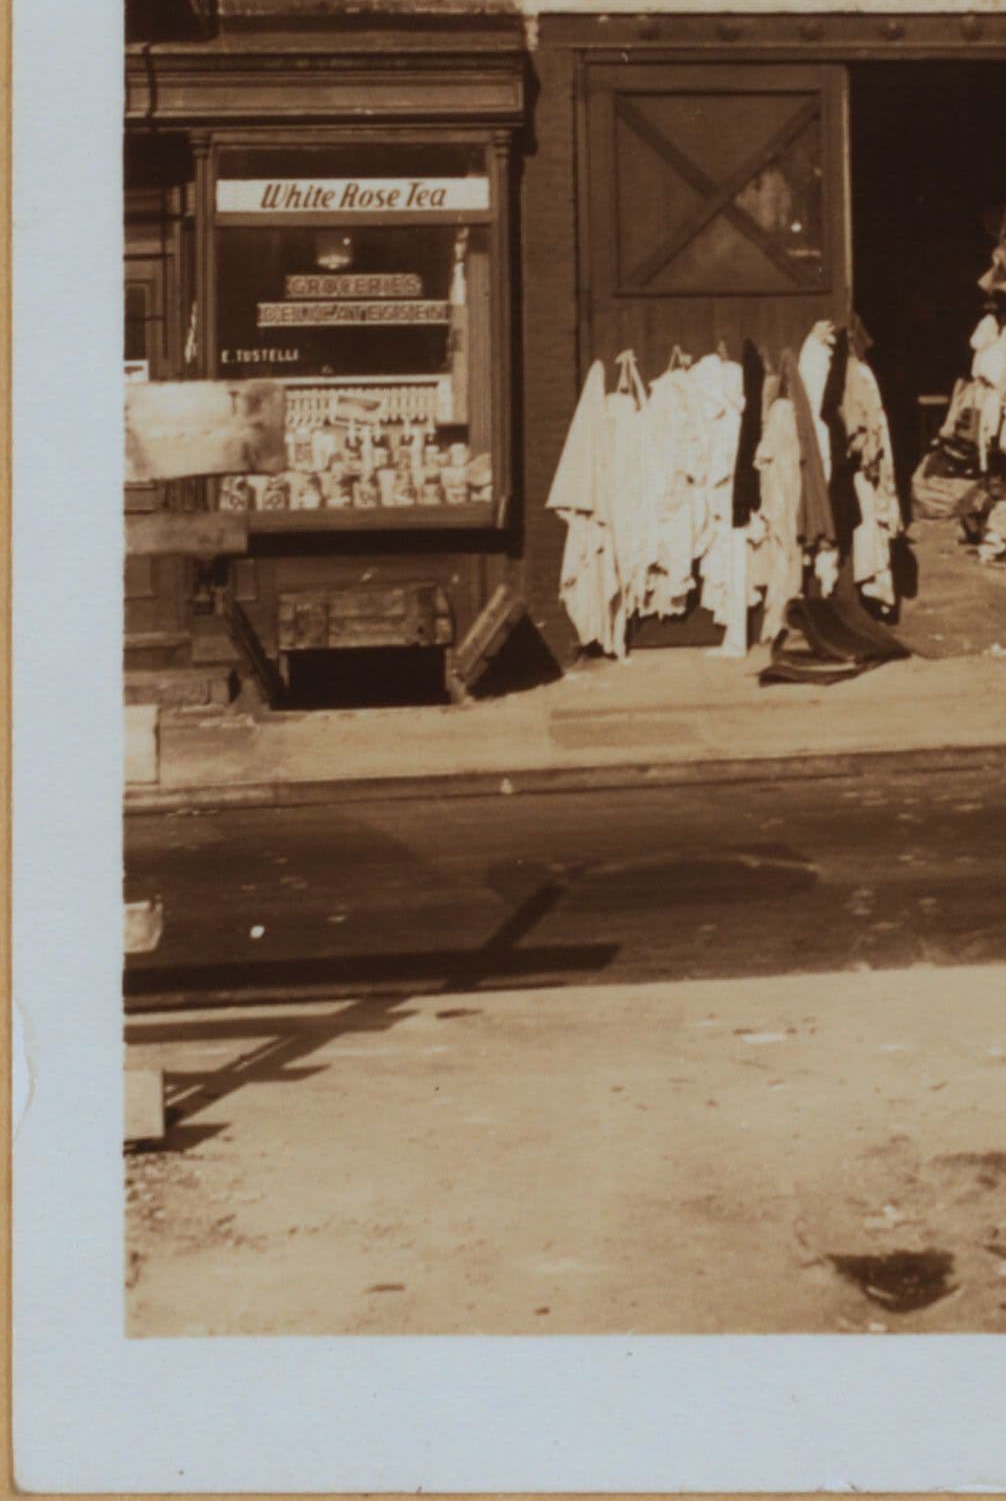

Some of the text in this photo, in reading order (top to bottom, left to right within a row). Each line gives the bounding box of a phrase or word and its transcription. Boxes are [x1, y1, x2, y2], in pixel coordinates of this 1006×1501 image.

[260, 181, 449, 209] White Rose Tea
[288, 274, 419, 295] GROCERIES
